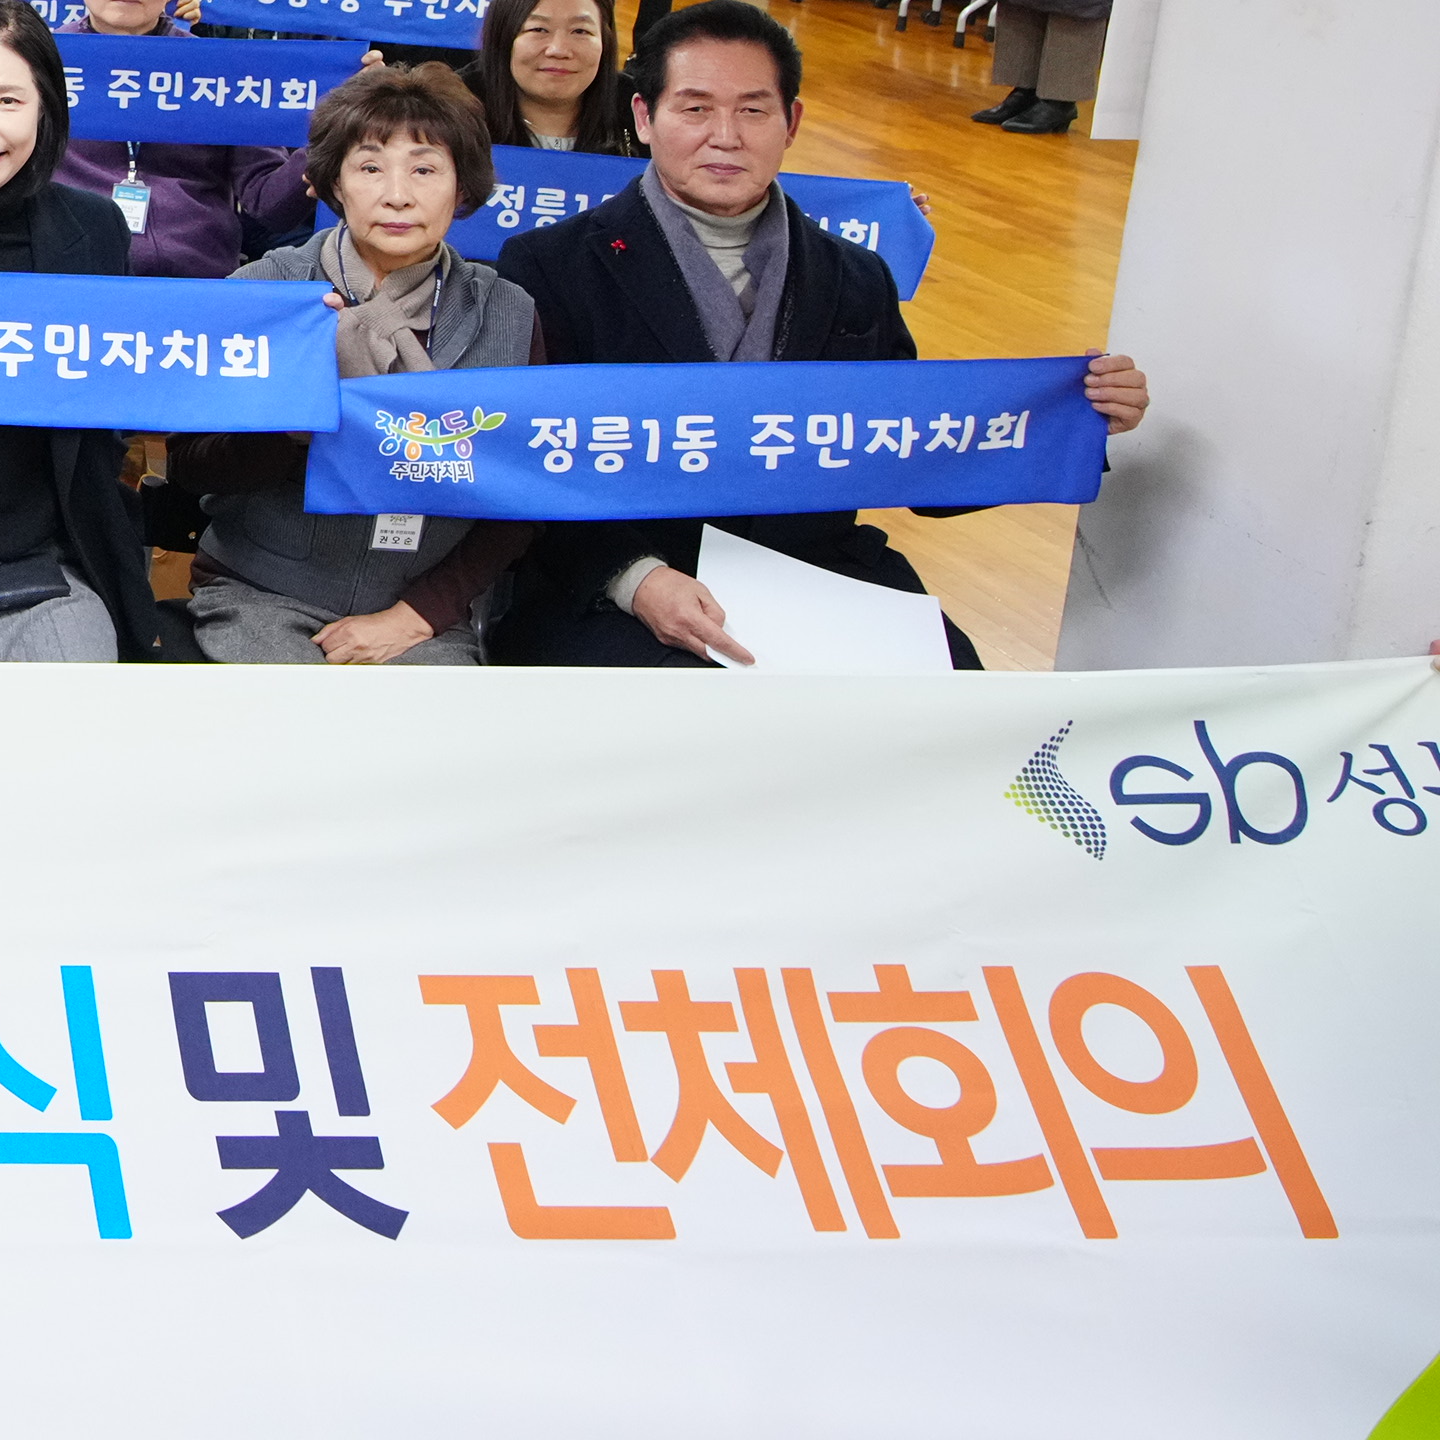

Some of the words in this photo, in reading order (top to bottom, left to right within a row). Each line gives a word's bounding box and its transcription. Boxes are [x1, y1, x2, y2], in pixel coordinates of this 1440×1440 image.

[108, 70, 316, 110] 주민자치회
[375, 408, 475, 463] 정릉1동
[528, 415, 717, 473] 정릉1동
[750, 411, 1029, 469] 주민자치회
[387, 461, 475, 483] 주민자치회
[1108, 718, 1309, 848] sb
[1326, 740, 1440, 837] 성
[166, 964, 410, 1243] 및
[417, 962, 1340, 1242] 전체회의
